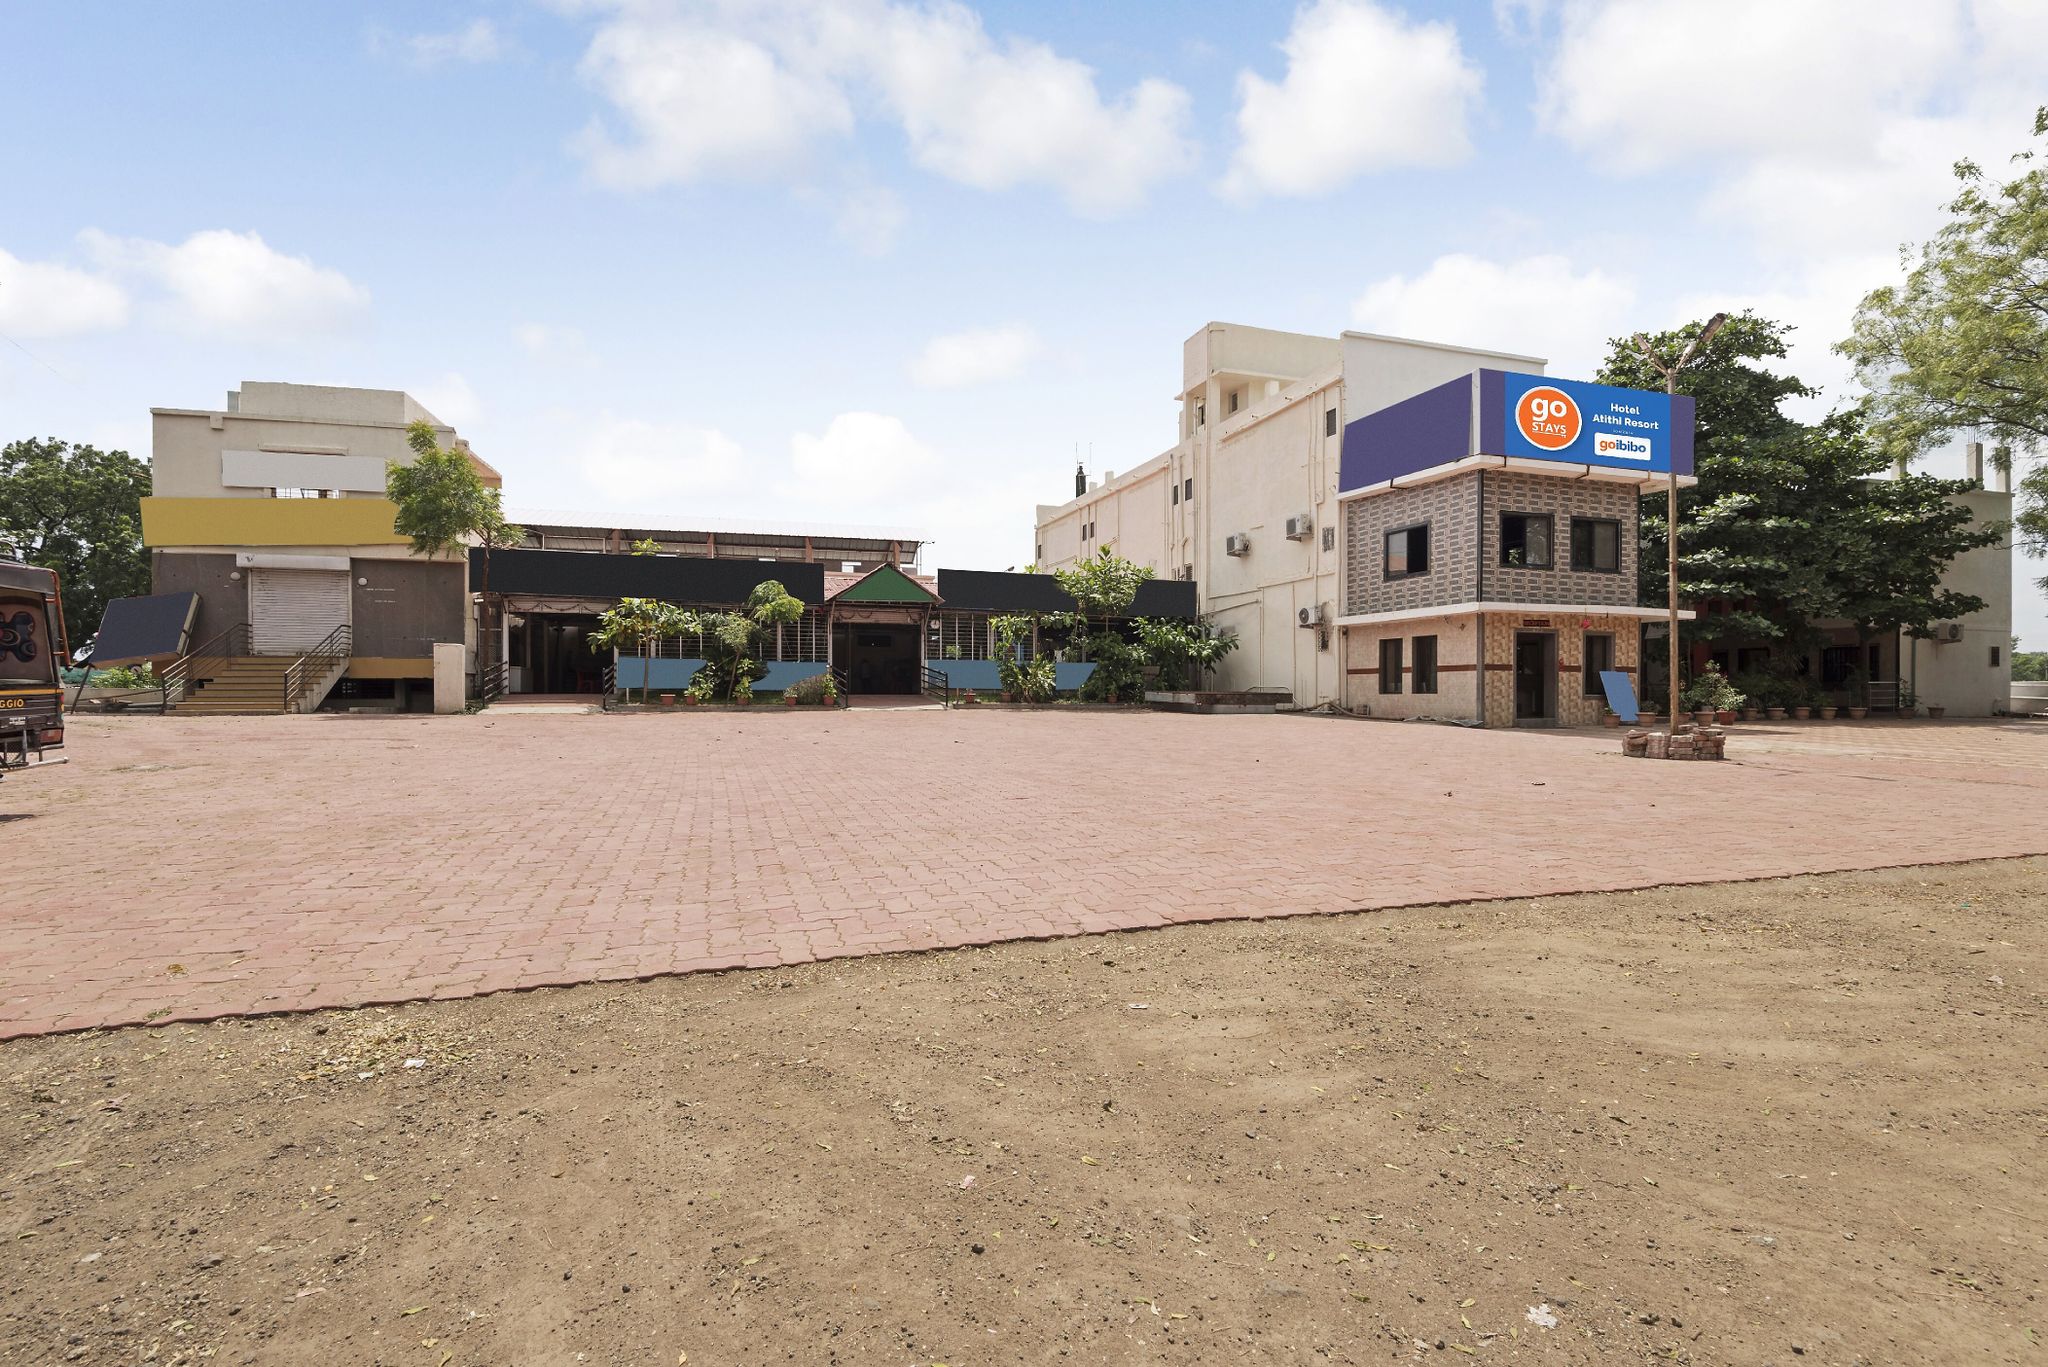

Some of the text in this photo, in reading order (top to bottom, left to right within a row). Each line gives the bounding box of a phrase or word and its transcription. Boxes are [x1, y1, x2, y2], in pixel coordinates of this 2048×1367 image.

[1531, 397, 1567, 421] go
[1610, 403, 1640, 415] Hotel
[1532, 421, 1566, 435] STAYS
[1592, 414, 1659, 429] Atithi Resort
[1599, 439, 1646, 453] goibibo
